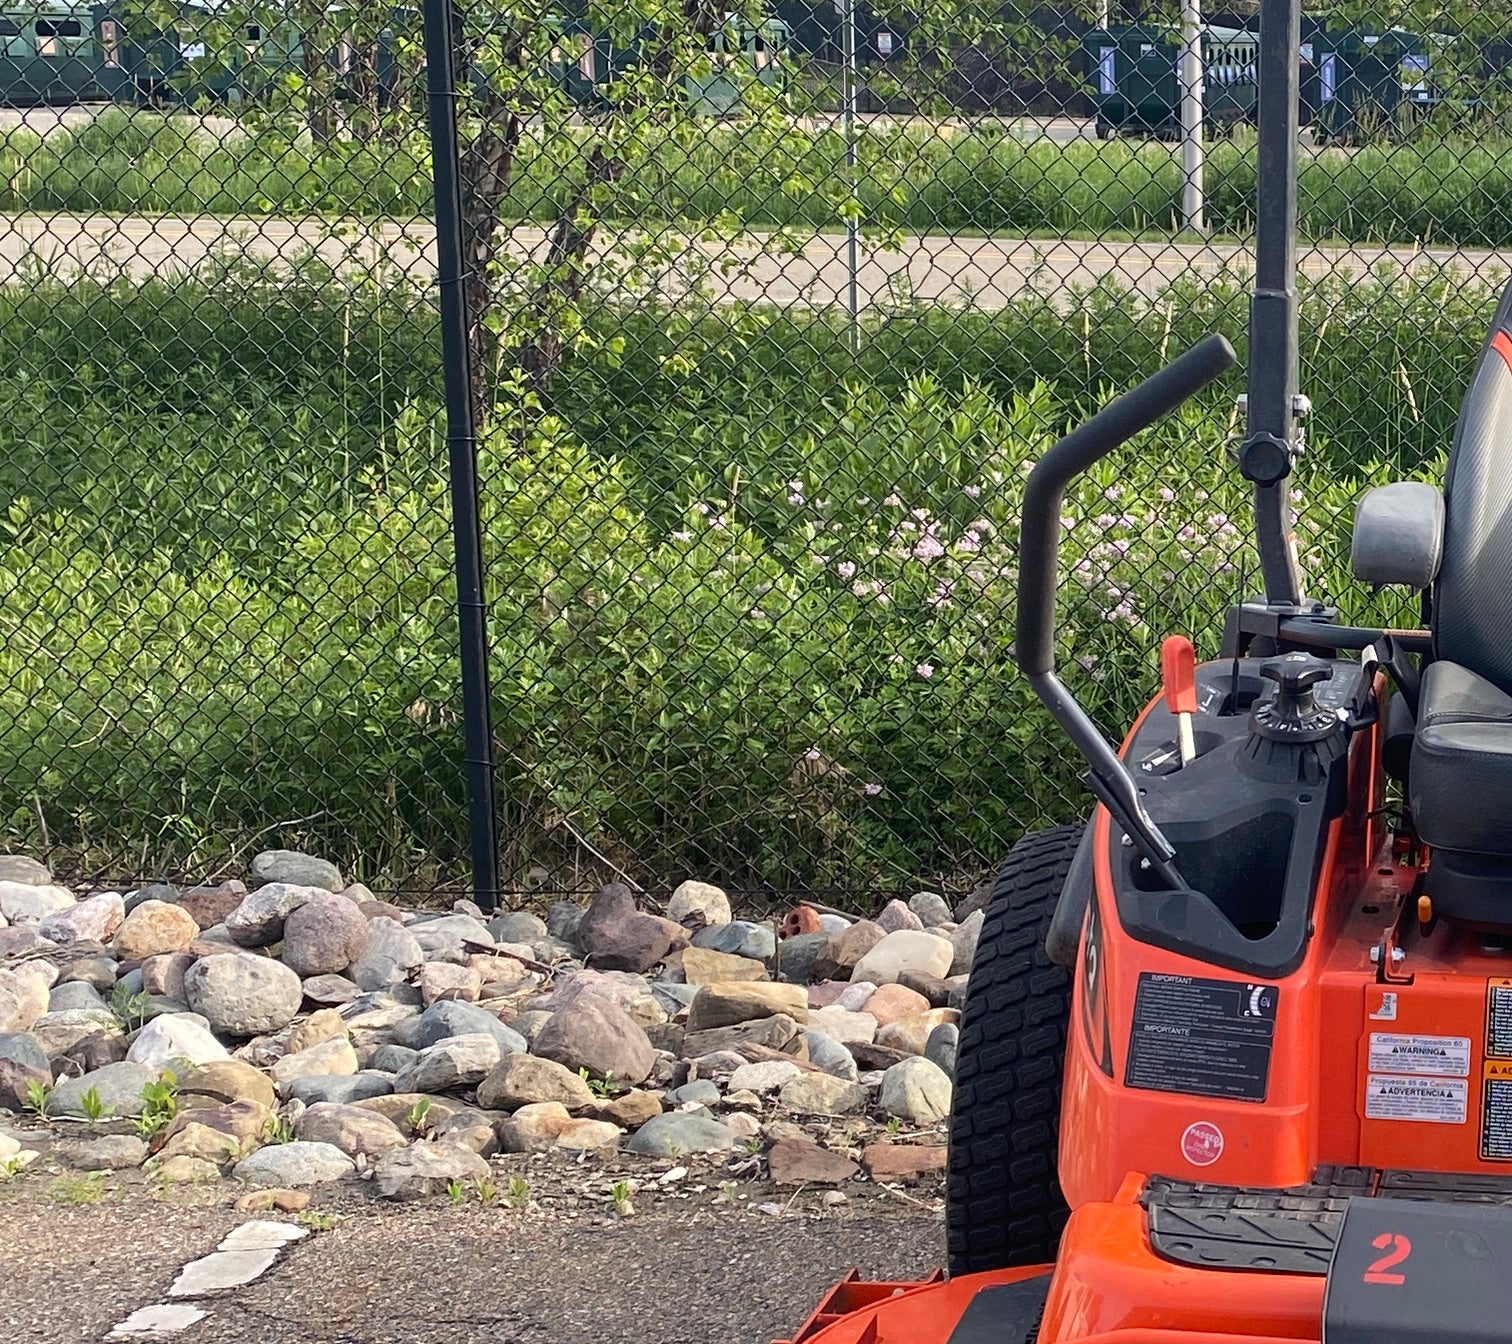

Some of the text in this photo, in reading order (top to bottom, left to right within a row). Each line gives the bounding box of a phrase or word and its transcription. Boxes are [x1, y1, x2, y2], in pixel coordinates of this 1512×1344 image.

[1151, 975, 1193, 985] IMPORTANT
[1144, 1024, 1190, 1036] IMPORTANTE
[1376, 1036, 1411, 1044] California
[1412, 1038, 1453, 1047] Proposition
[1398, 1046, 1441, 1056] WARNING
[1370, 1077, 1406, 1087] Propuesta
[1430, 1081, 1464, 1089] California
[1388, 1087, 1446, 1097] ADVERTENCIA
[1363, 1233, 1412, 1285] 2
